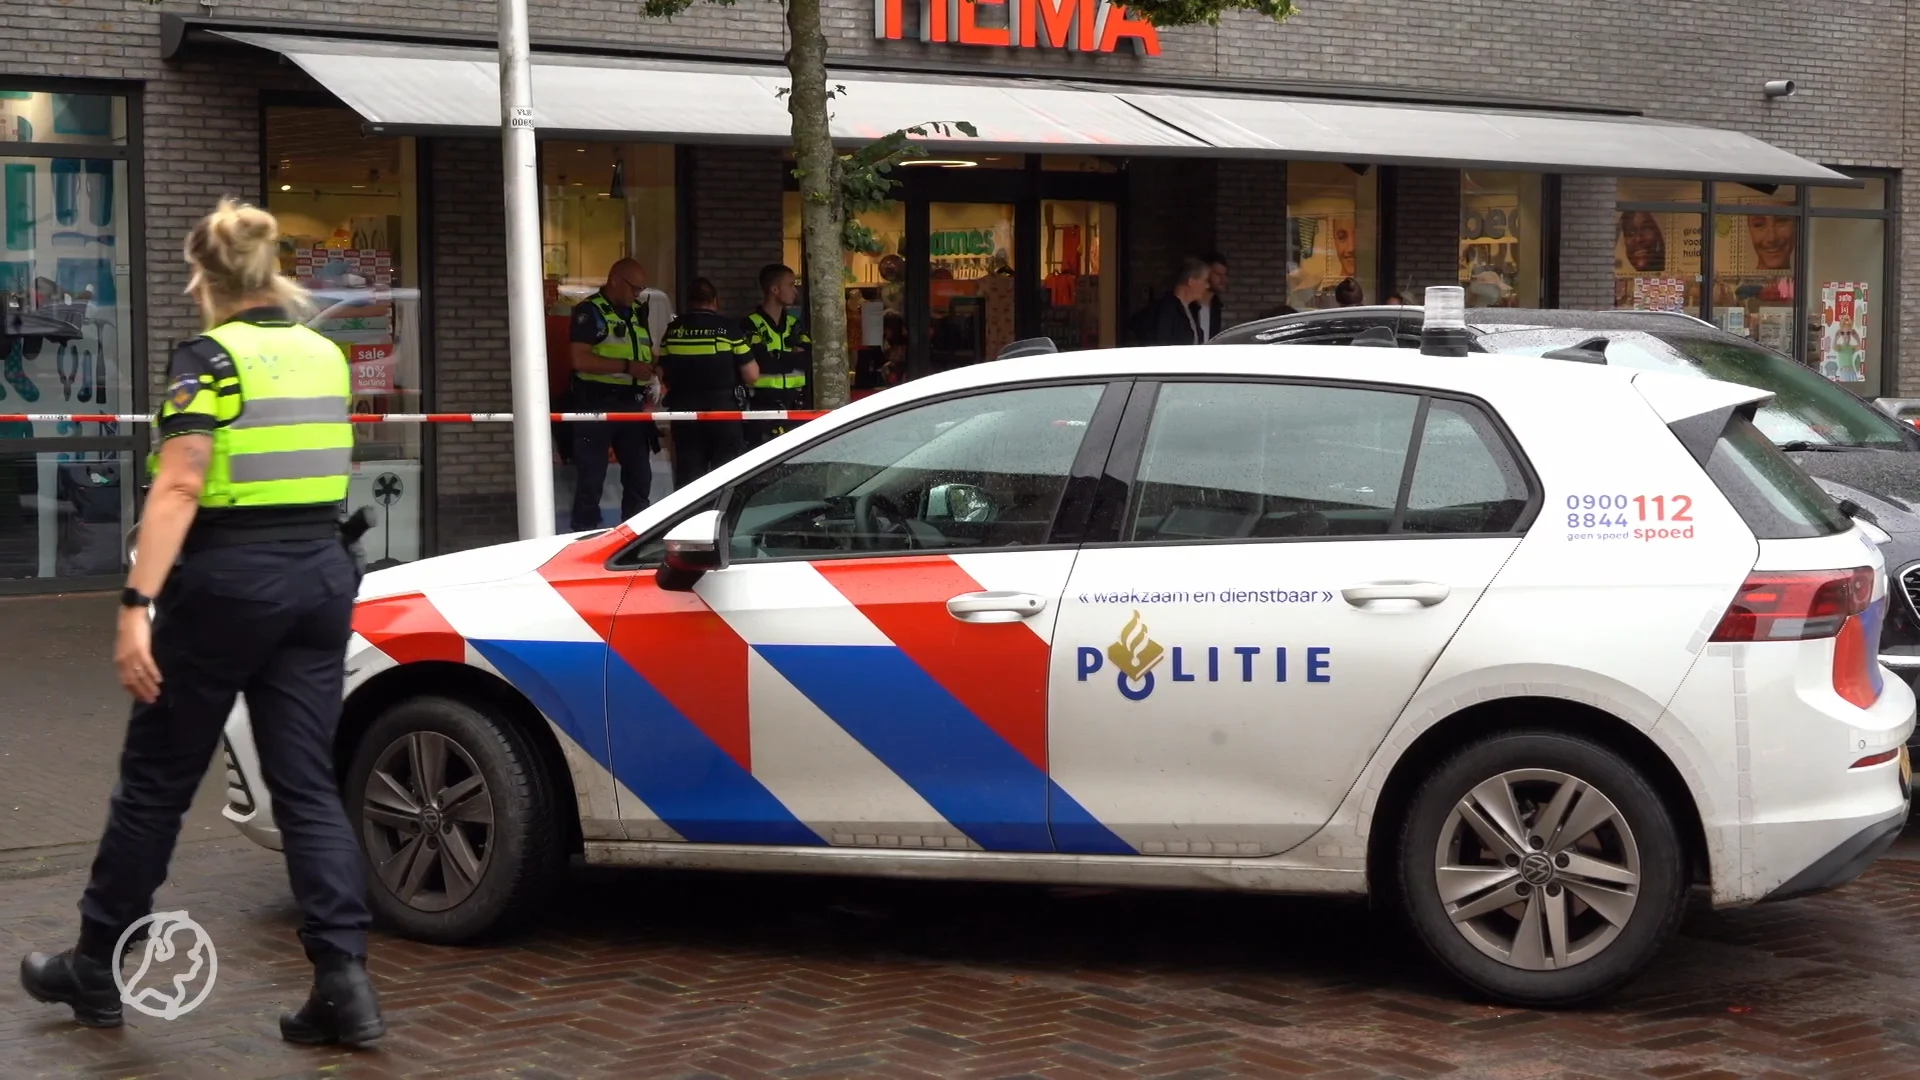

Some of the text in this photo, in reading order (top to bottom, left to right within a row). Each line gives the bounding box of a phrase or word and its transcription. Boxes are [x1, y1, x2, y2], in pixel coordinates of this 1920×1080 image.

[930, 229, 995, 256] ames
[358, 347, 386, 360] sale
[358, 365, 386, 379] 30%
[1566, 494, 1628, 510] 0900
[1632, 494, 1694, 522] 112
[1566, 513, 1629, 528] 8844
[1567, 531, 1630, 541] geen spoed
[1633, 524, 1695, 543] spoed
[1093, 588, 1190, 604] waakzaam
[1193, 591, 1216, 603] en
[1219, 587, 1319, 603] dienstbaar
[1077, 645, 1331, 701] POLITIE
